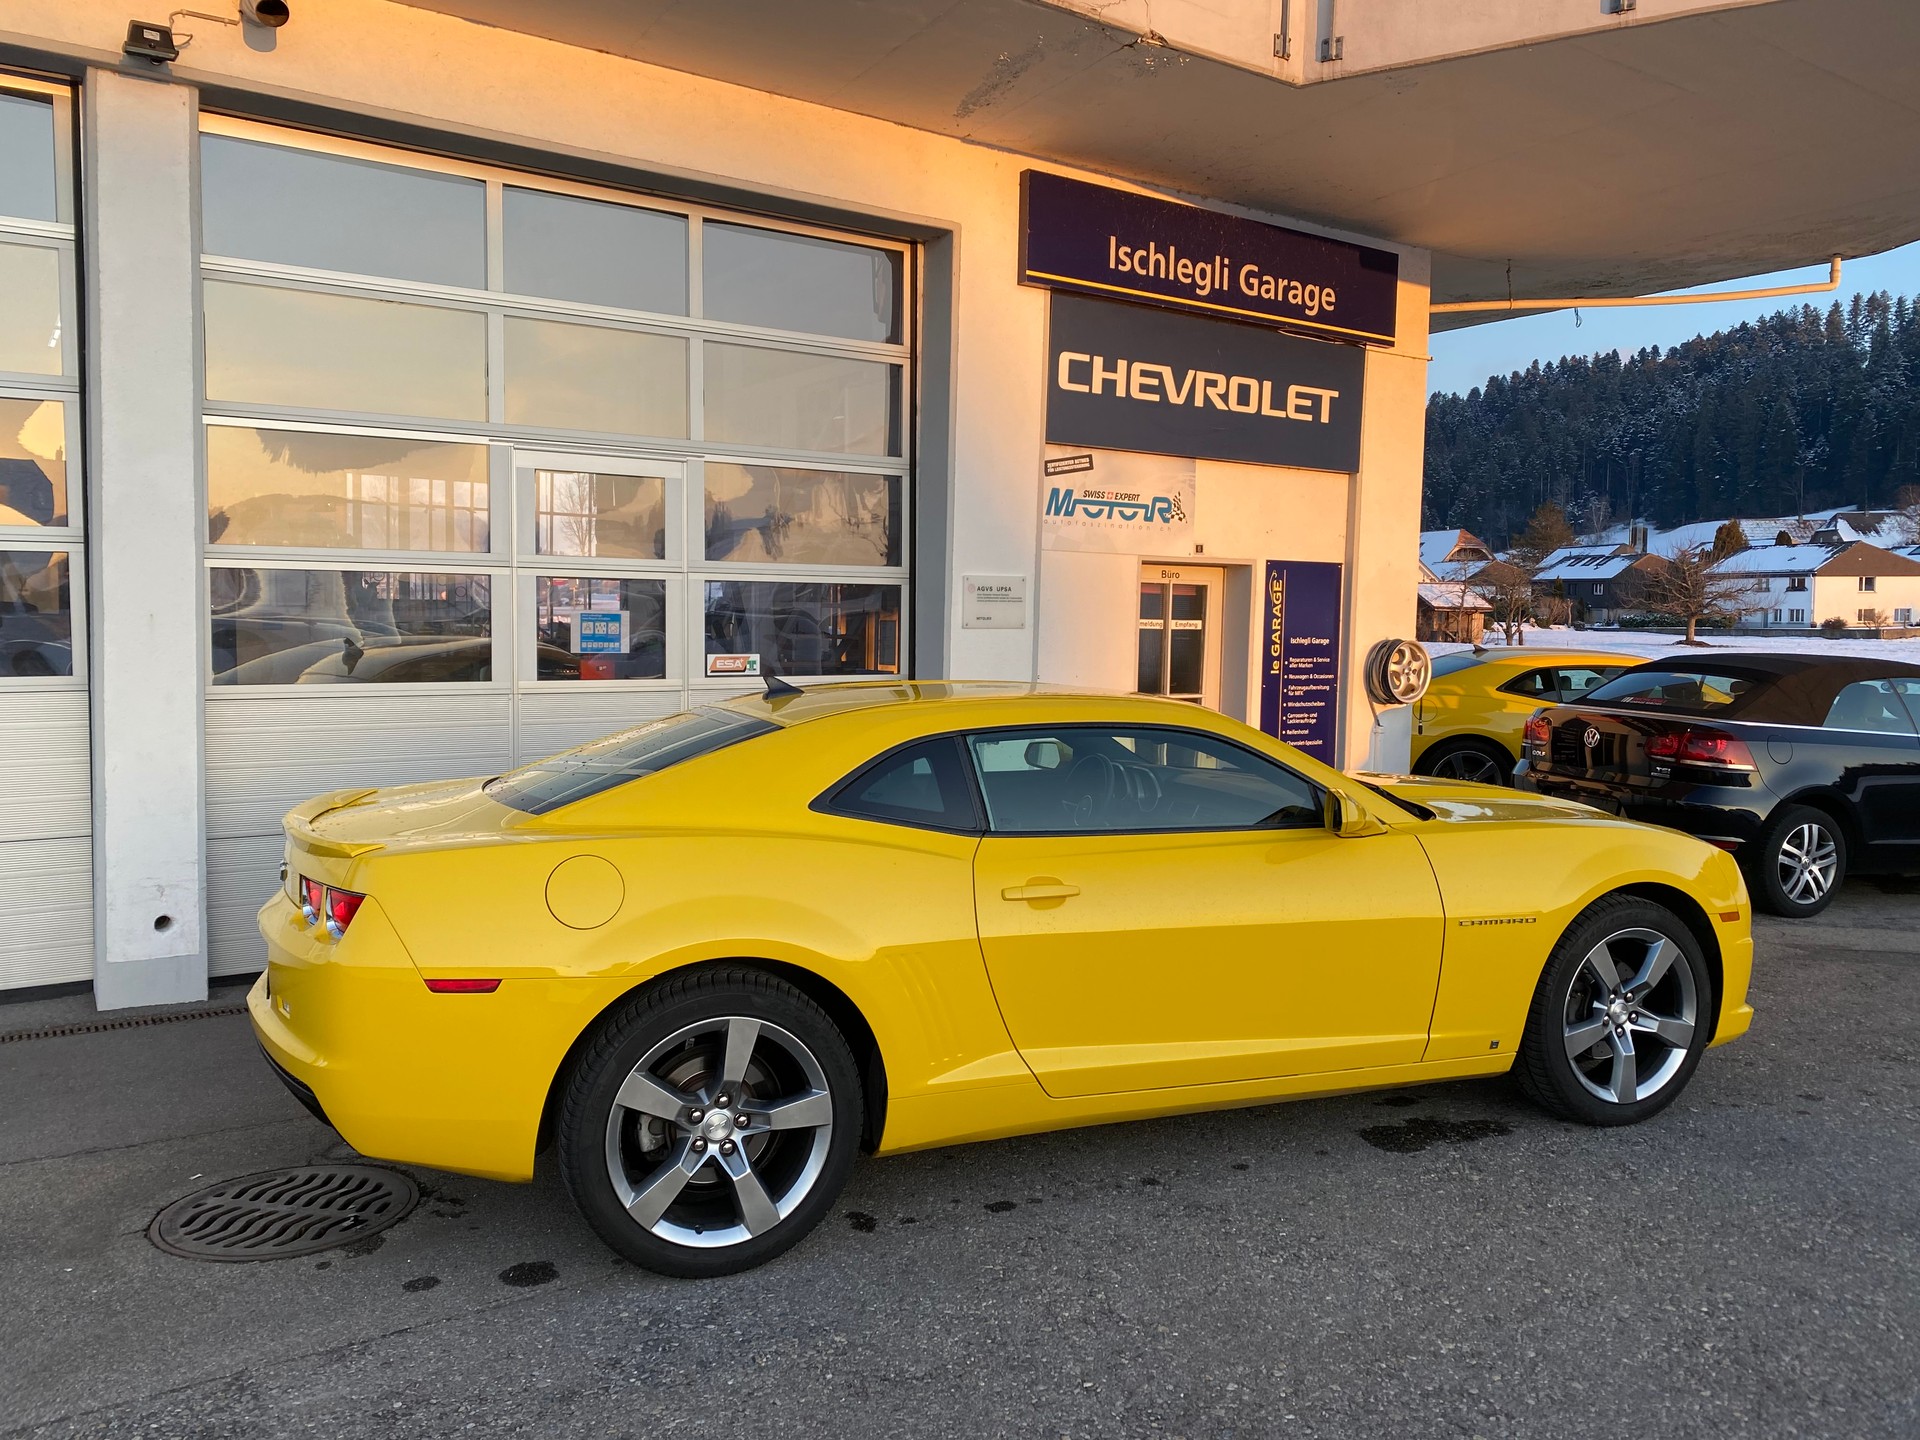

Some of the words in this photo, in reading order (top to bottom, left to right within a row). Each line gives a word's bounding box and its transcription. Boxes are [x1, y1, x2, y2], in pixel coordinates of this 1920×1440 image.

[1108, 235, 1229, 296] Ischlegli
[1238, 264, 1336, 316] Garage
[1058, 351, 1339, 424] CHEVROLET
[1083, 490, 1106, 499] SWISS
[1114, 492, 1141, 502] EXPERT
[1045, 487, 1172, 524] MOTOR
[1161, 569, 1181, 579] Büro
[1271, 579, 1283, 657] GARAGE
[1174, 621, 1199, 629] Empfang
[1290, 637, 1311, 646] Ischlegli
[1270, 660, 1280, 675] le
[1532, 749, 1546, 757] GOLF
[1459, 917, 1537, 927] CAMARO
